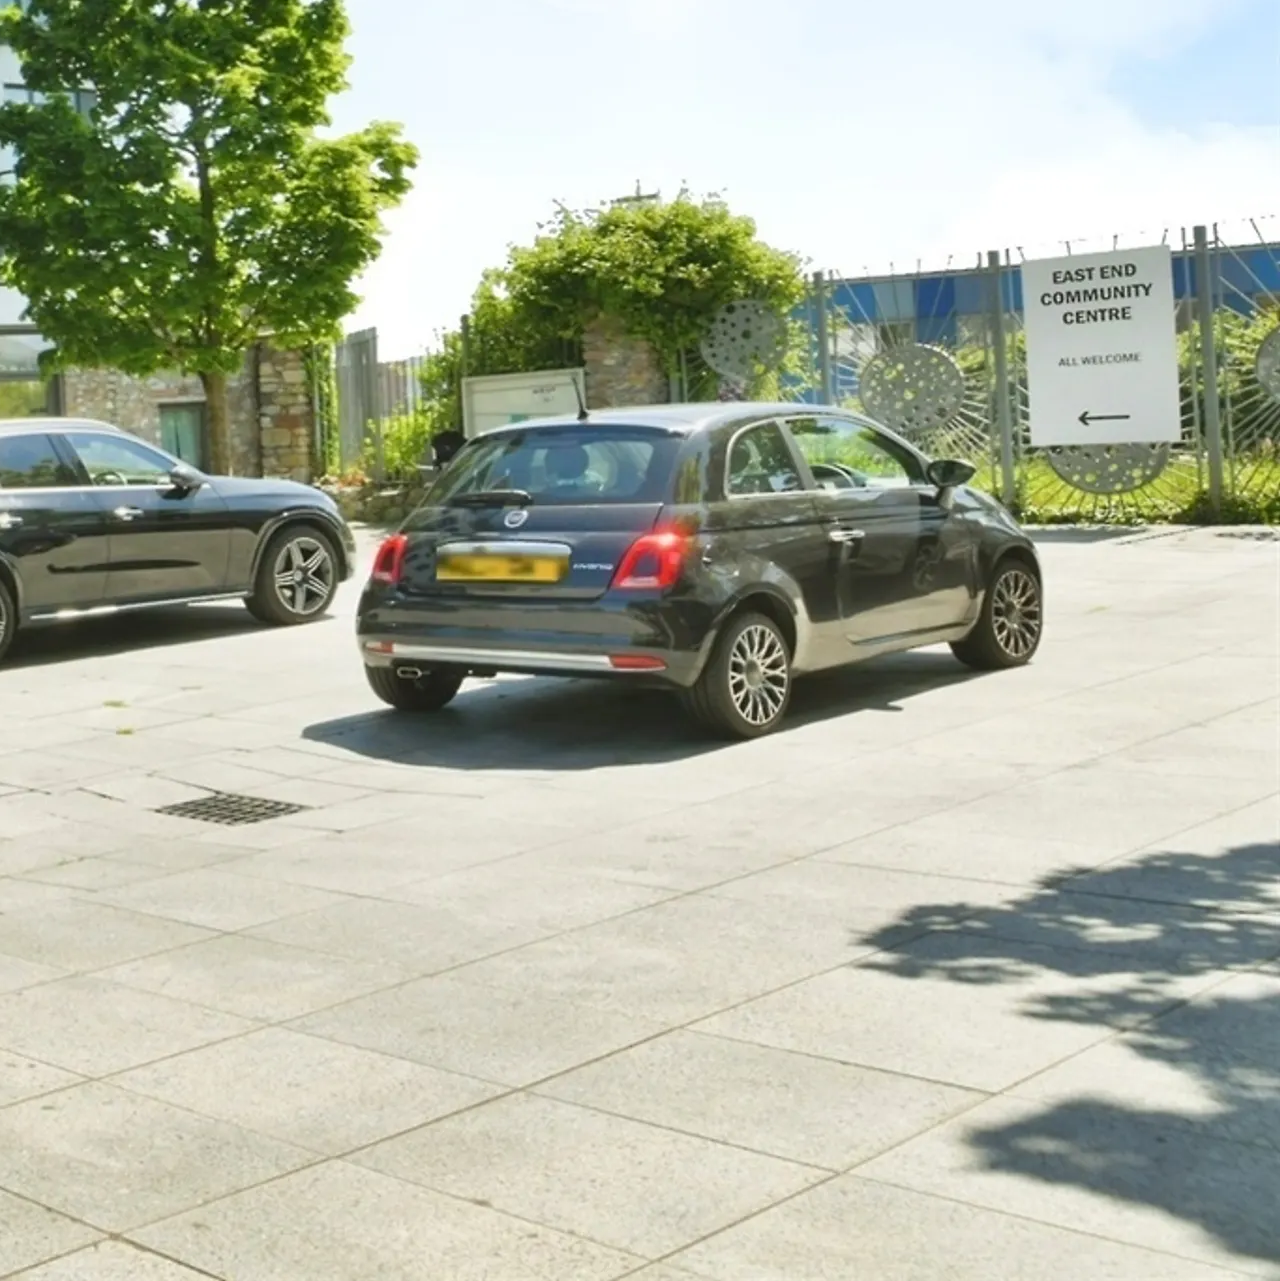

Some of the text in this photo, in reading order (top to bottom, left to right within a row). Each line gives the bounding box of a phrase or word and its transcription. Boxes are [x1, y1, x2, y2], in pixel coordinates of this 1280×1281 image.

[1052, 263, 1137, 284] EAST END
[1040, 283, 1153, 306] COMMUNITY
[1062, 306, 1132, 325] CENTRE
[1058, 353, 1140, 367] ALL WELCOME
